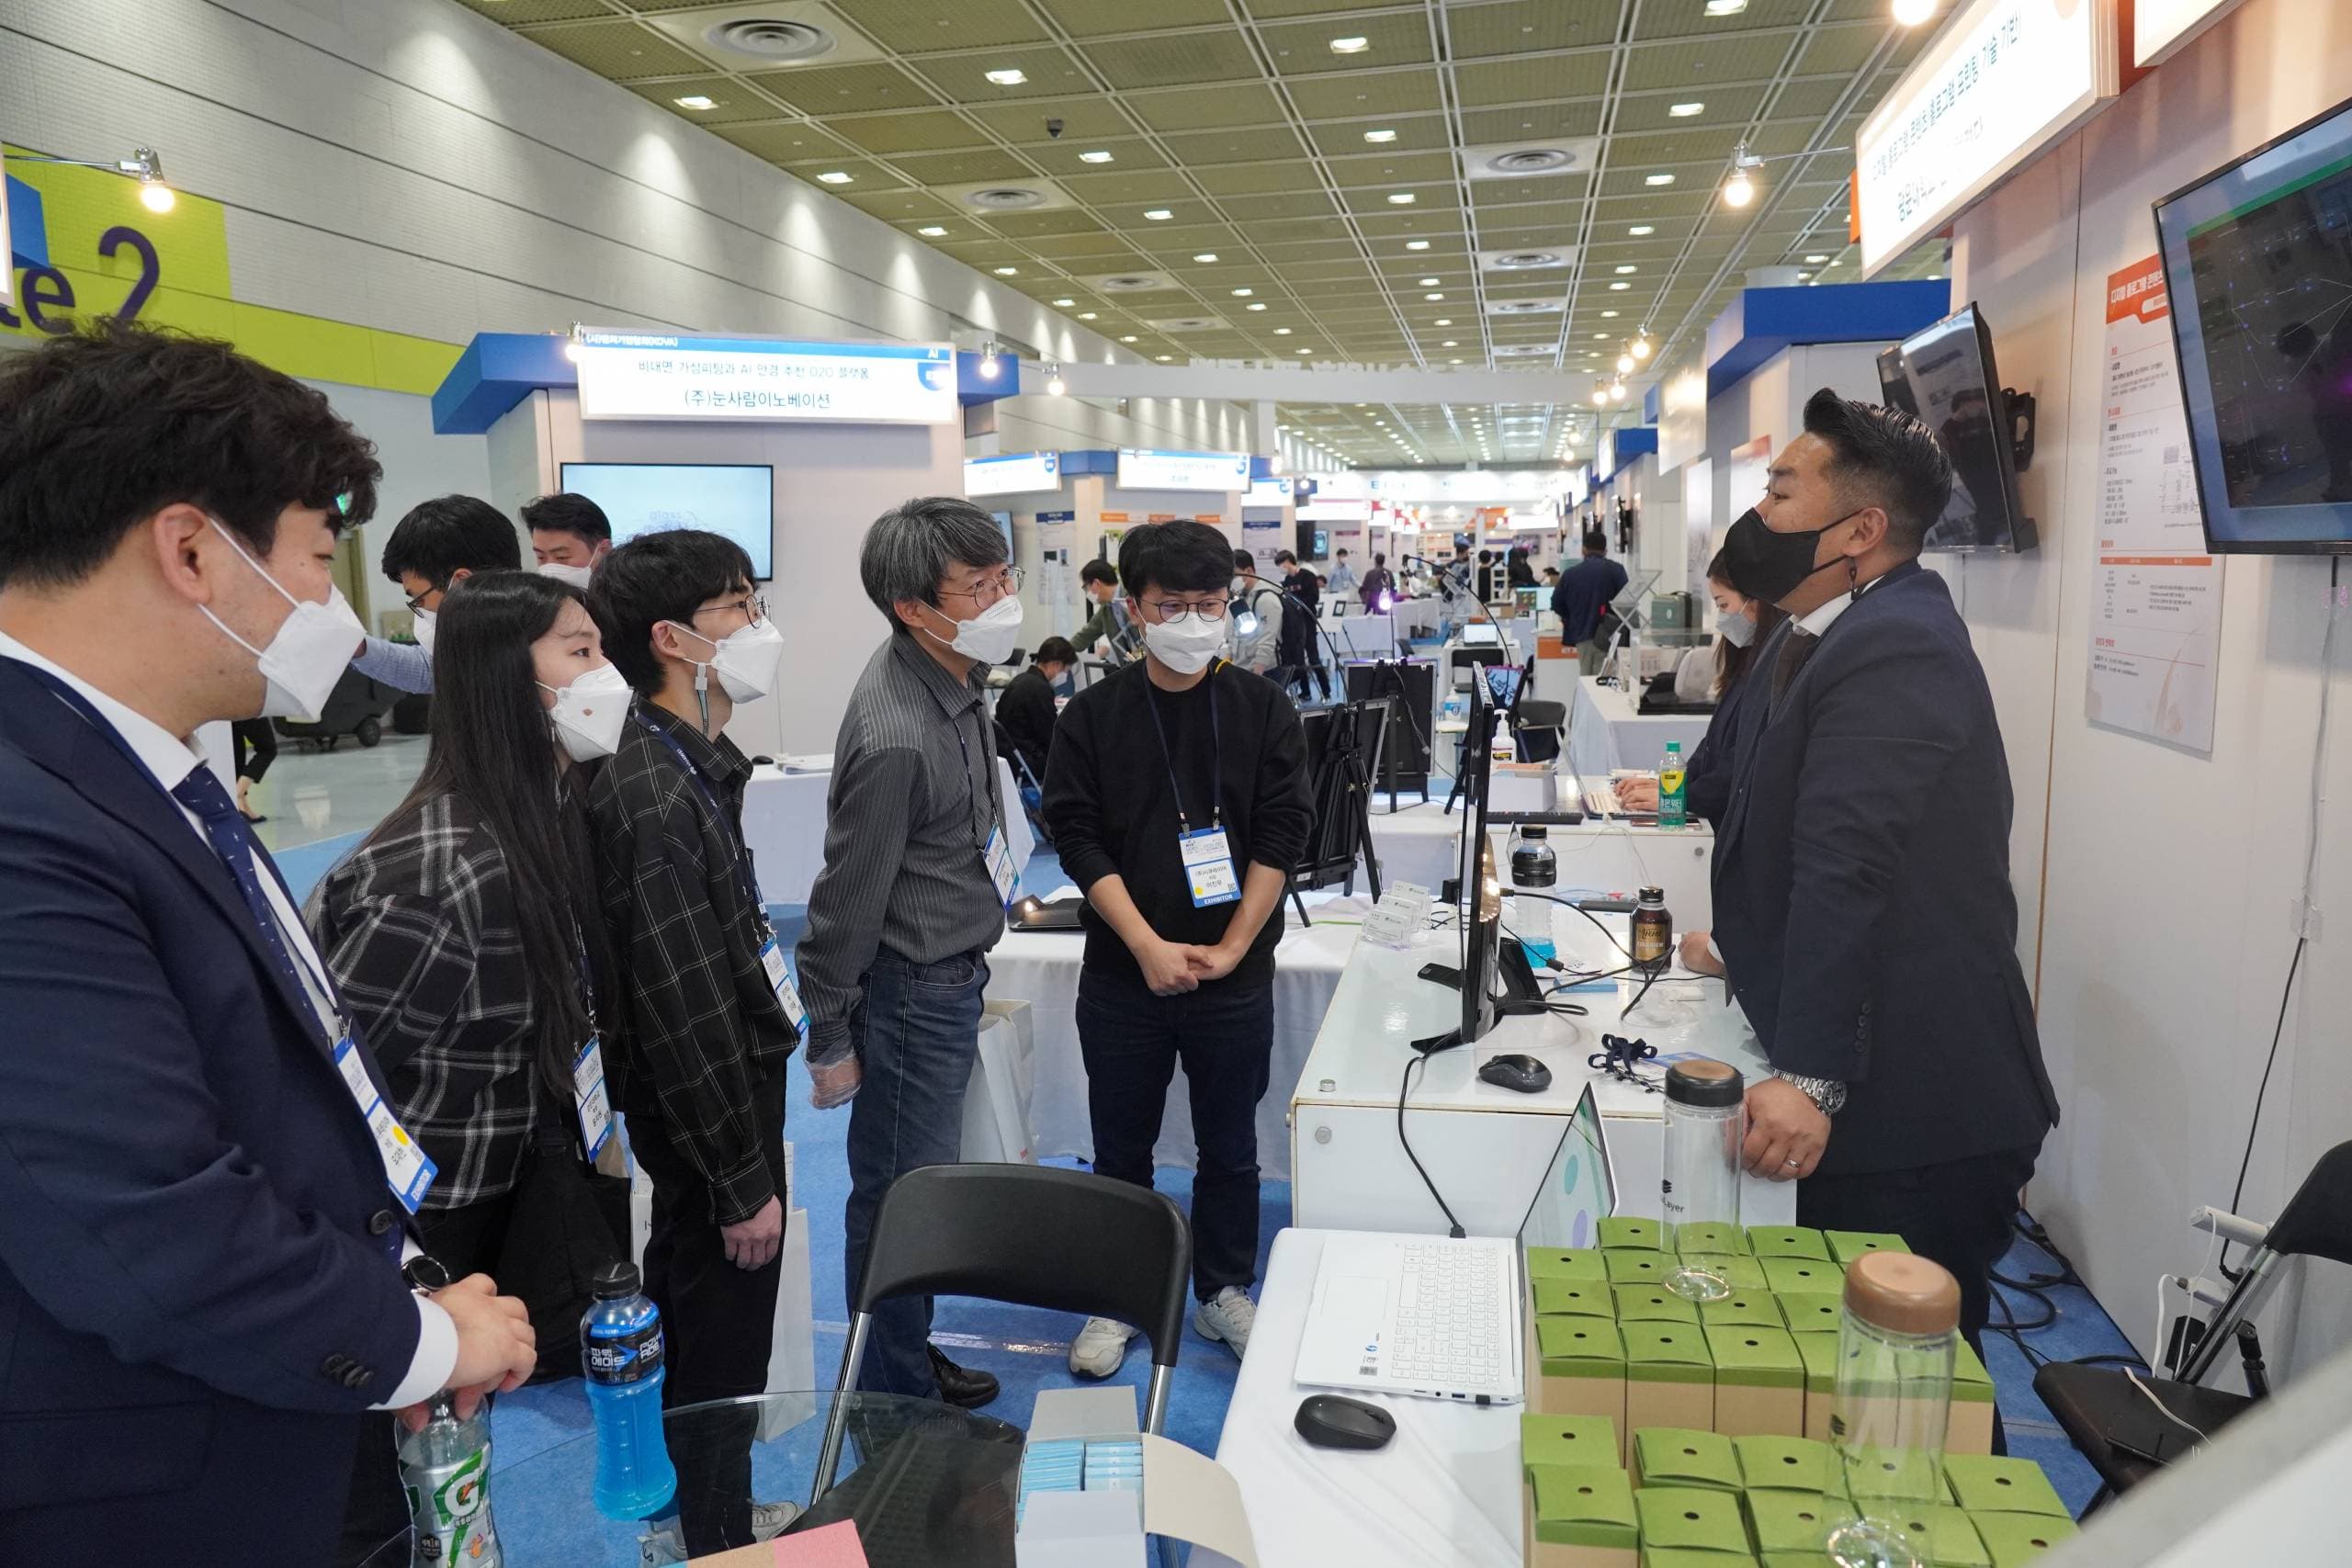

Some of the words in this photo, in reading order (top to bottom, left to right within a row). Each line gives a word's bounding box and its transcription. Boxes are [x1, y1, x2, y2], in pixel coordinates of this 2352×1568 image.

[98, 226, 160, 321] 2
[638, 360, 673, 374] 비대면
[679, 361, 736, 376] 가상피팅과
[740, 365, 752, 375] AI
[756, 364, 780, 377] 안경
[837, 366, 870, 380] 플랫폼
[684, 389, 831, 410] (주)눈사람이노베이션
[1204, 894, 1233, 905] EXHIBITOR
[445, 1470, 481, 1517] G
